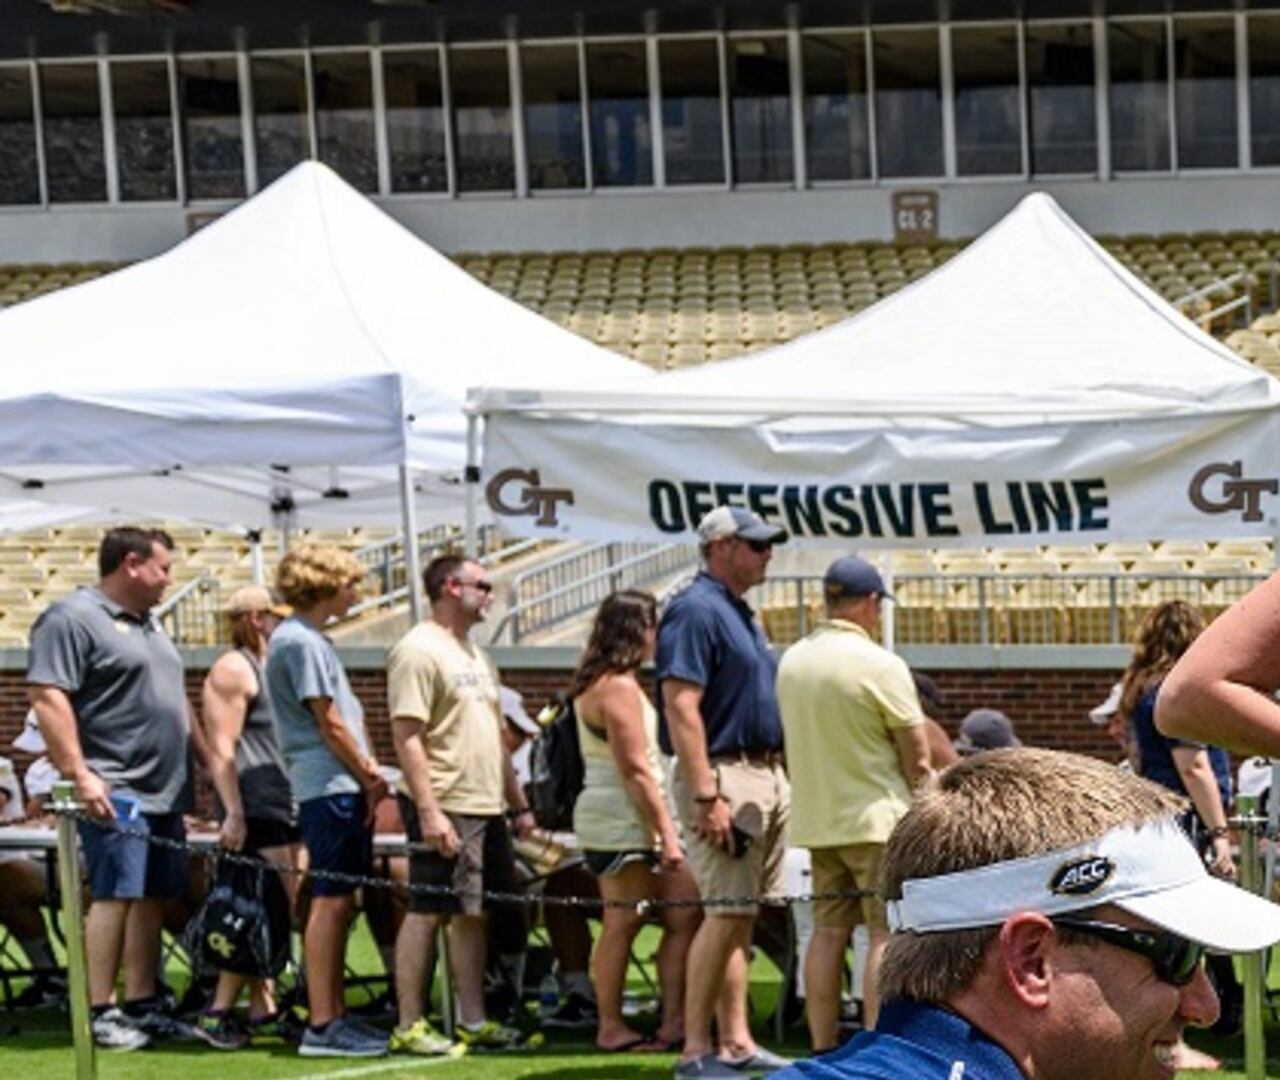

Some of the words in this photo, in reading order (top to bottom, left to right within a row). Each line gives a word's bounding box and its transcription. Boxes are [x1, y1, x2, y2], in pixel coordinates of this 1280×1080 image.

[486, 469, 574, 527] GT
[973, 477, 1109, 534] LINE
[1188, 461, 1278, 522] GT
[1061, 859, 1106, 888] ACC
